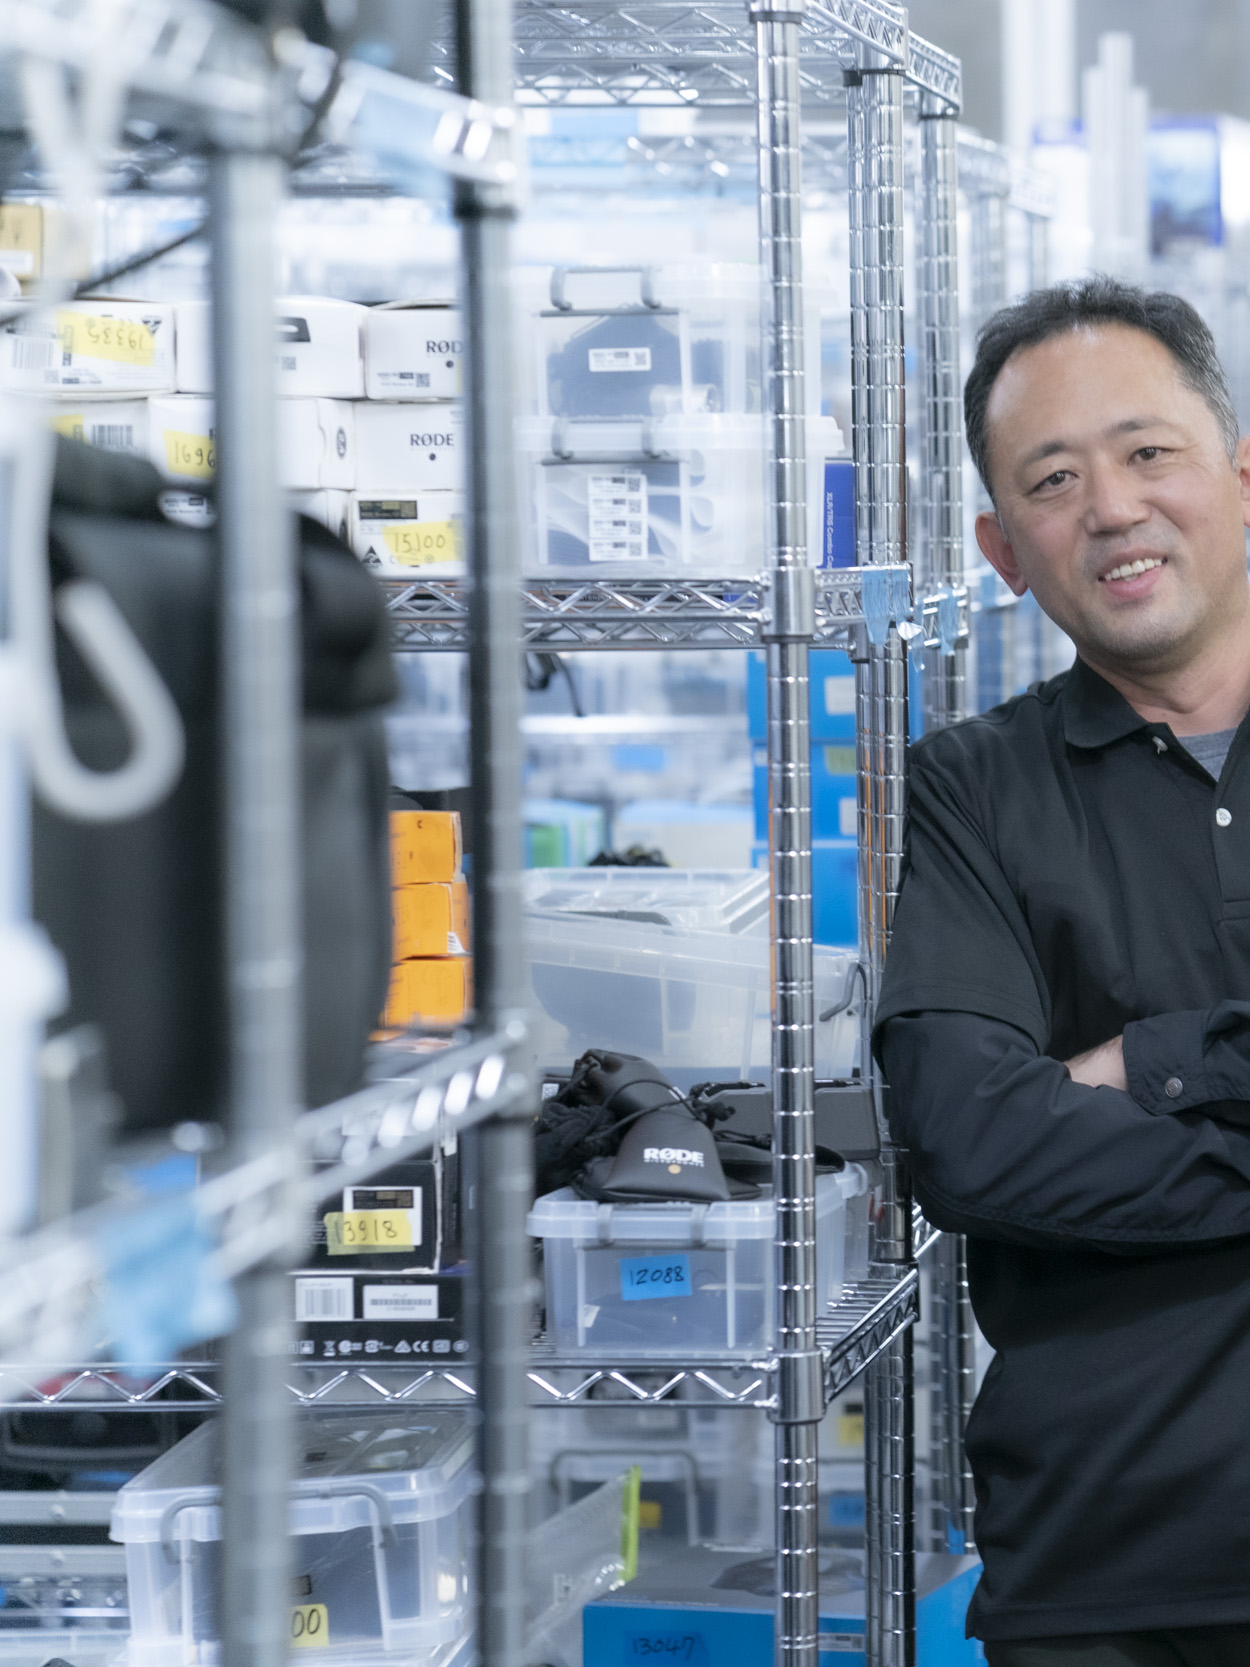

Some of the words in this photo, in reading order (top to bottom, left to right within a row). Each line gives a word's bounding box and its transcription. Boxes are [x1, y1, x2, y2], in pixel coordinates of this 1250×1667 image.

[425, 339, 464, 354] RØD
[410, 433, 455, 447] RØDE
[174, 439, 217, 469] 1696
[394, 531, 446, 554] 15100
[826, 527, 834, 554] Combo
[643, 1147, 705, 1164] RØDE
[334, 1218, 398, 1244] 13918
[629, 1265, 684, 1286] 12088
[291, 1608, 321, 1639] 00
[632, 1636, 696, 1660] 13047
